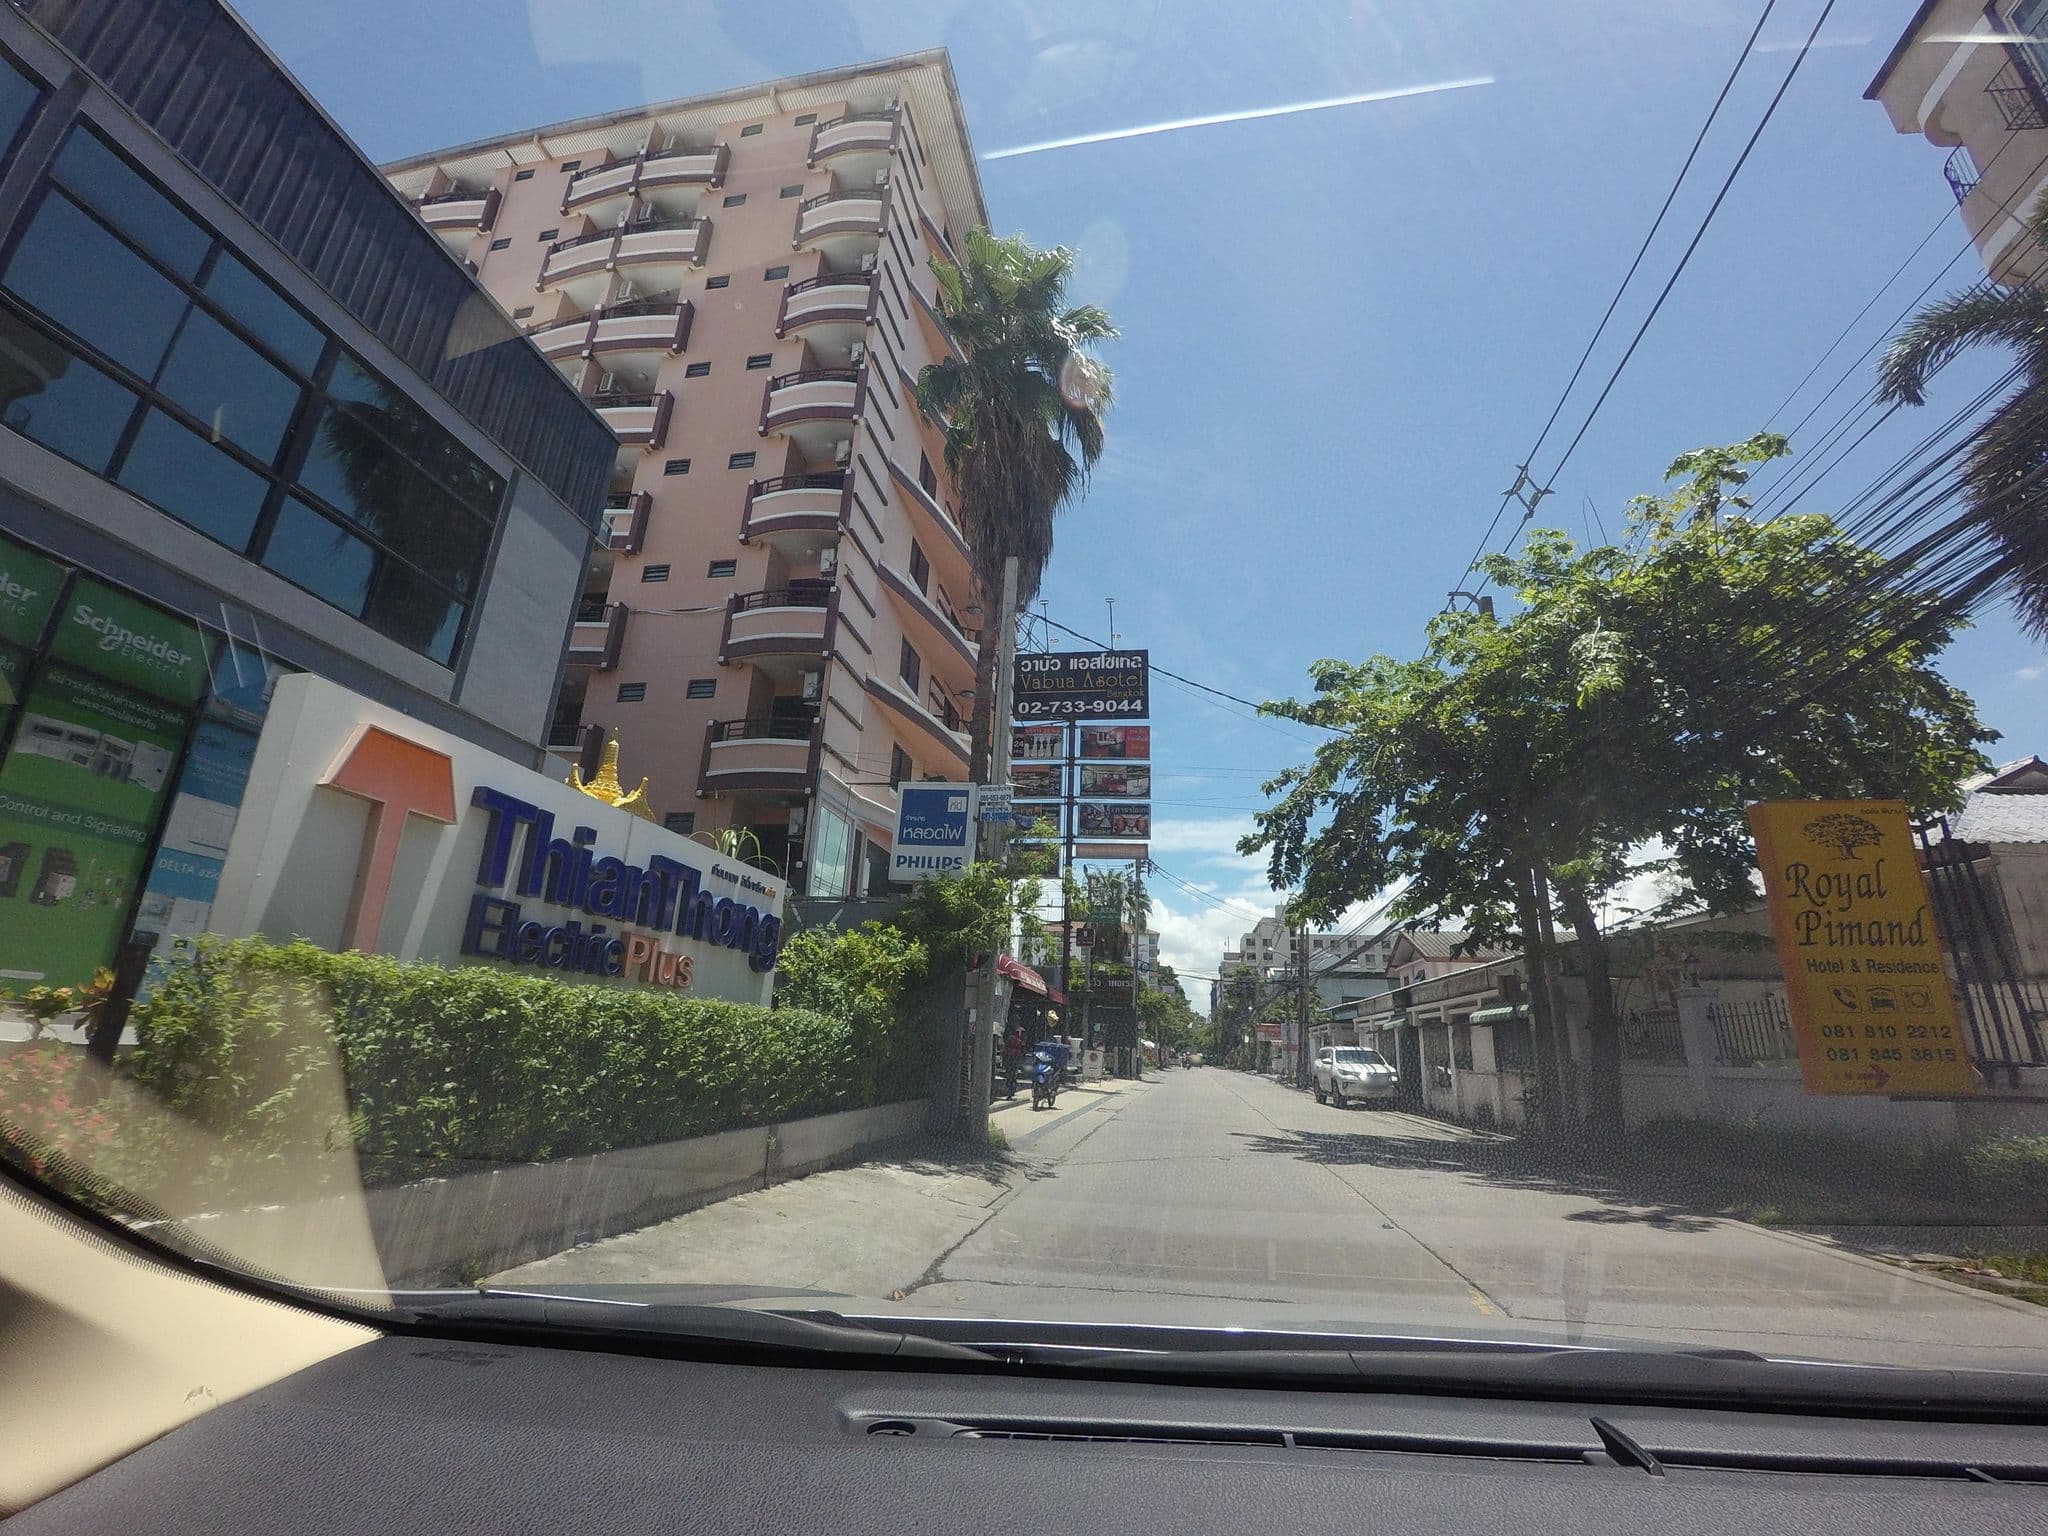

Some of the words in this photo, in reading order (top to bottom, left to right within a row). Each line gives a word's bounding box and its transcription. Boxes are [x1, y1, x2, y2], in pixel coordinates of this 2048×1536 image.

[73, 604, 192, 666] Schneider
[121, 644, 184, 680] Electric
[1020, 656, 1062, 672] วาบัว
[1020, 674, 1075, 690] Vabua
[1107, 689, 1145, 699] Bangkok
[1018, 699, 1143, 714] 02-733-9044
[0, 794, 48, 817] Control
[52, 810, 82, 825] and
[84, 815, 148, 843] Signalling
[902, 824, 963, 840] หลอดไฟ
[158, 858, 195, 875] DELTA
[896, 855, 963, 870] PHILIPS
[471, 786, 781, 973] ThianThong
[1785, 858, 1888, 912] Royal
[1794, 905, 1928, 947] Pimand
[1807, 958, 1844, 974] Hotel
[1850, 959, 1861, 974] &
[1866, 958, 1939, 975] Residence
[1822, 1024, 1855, 1039] 081
[1906, 1025, 1952, 1039] 2212
[1826, 1047, 1859, 1063] 081
